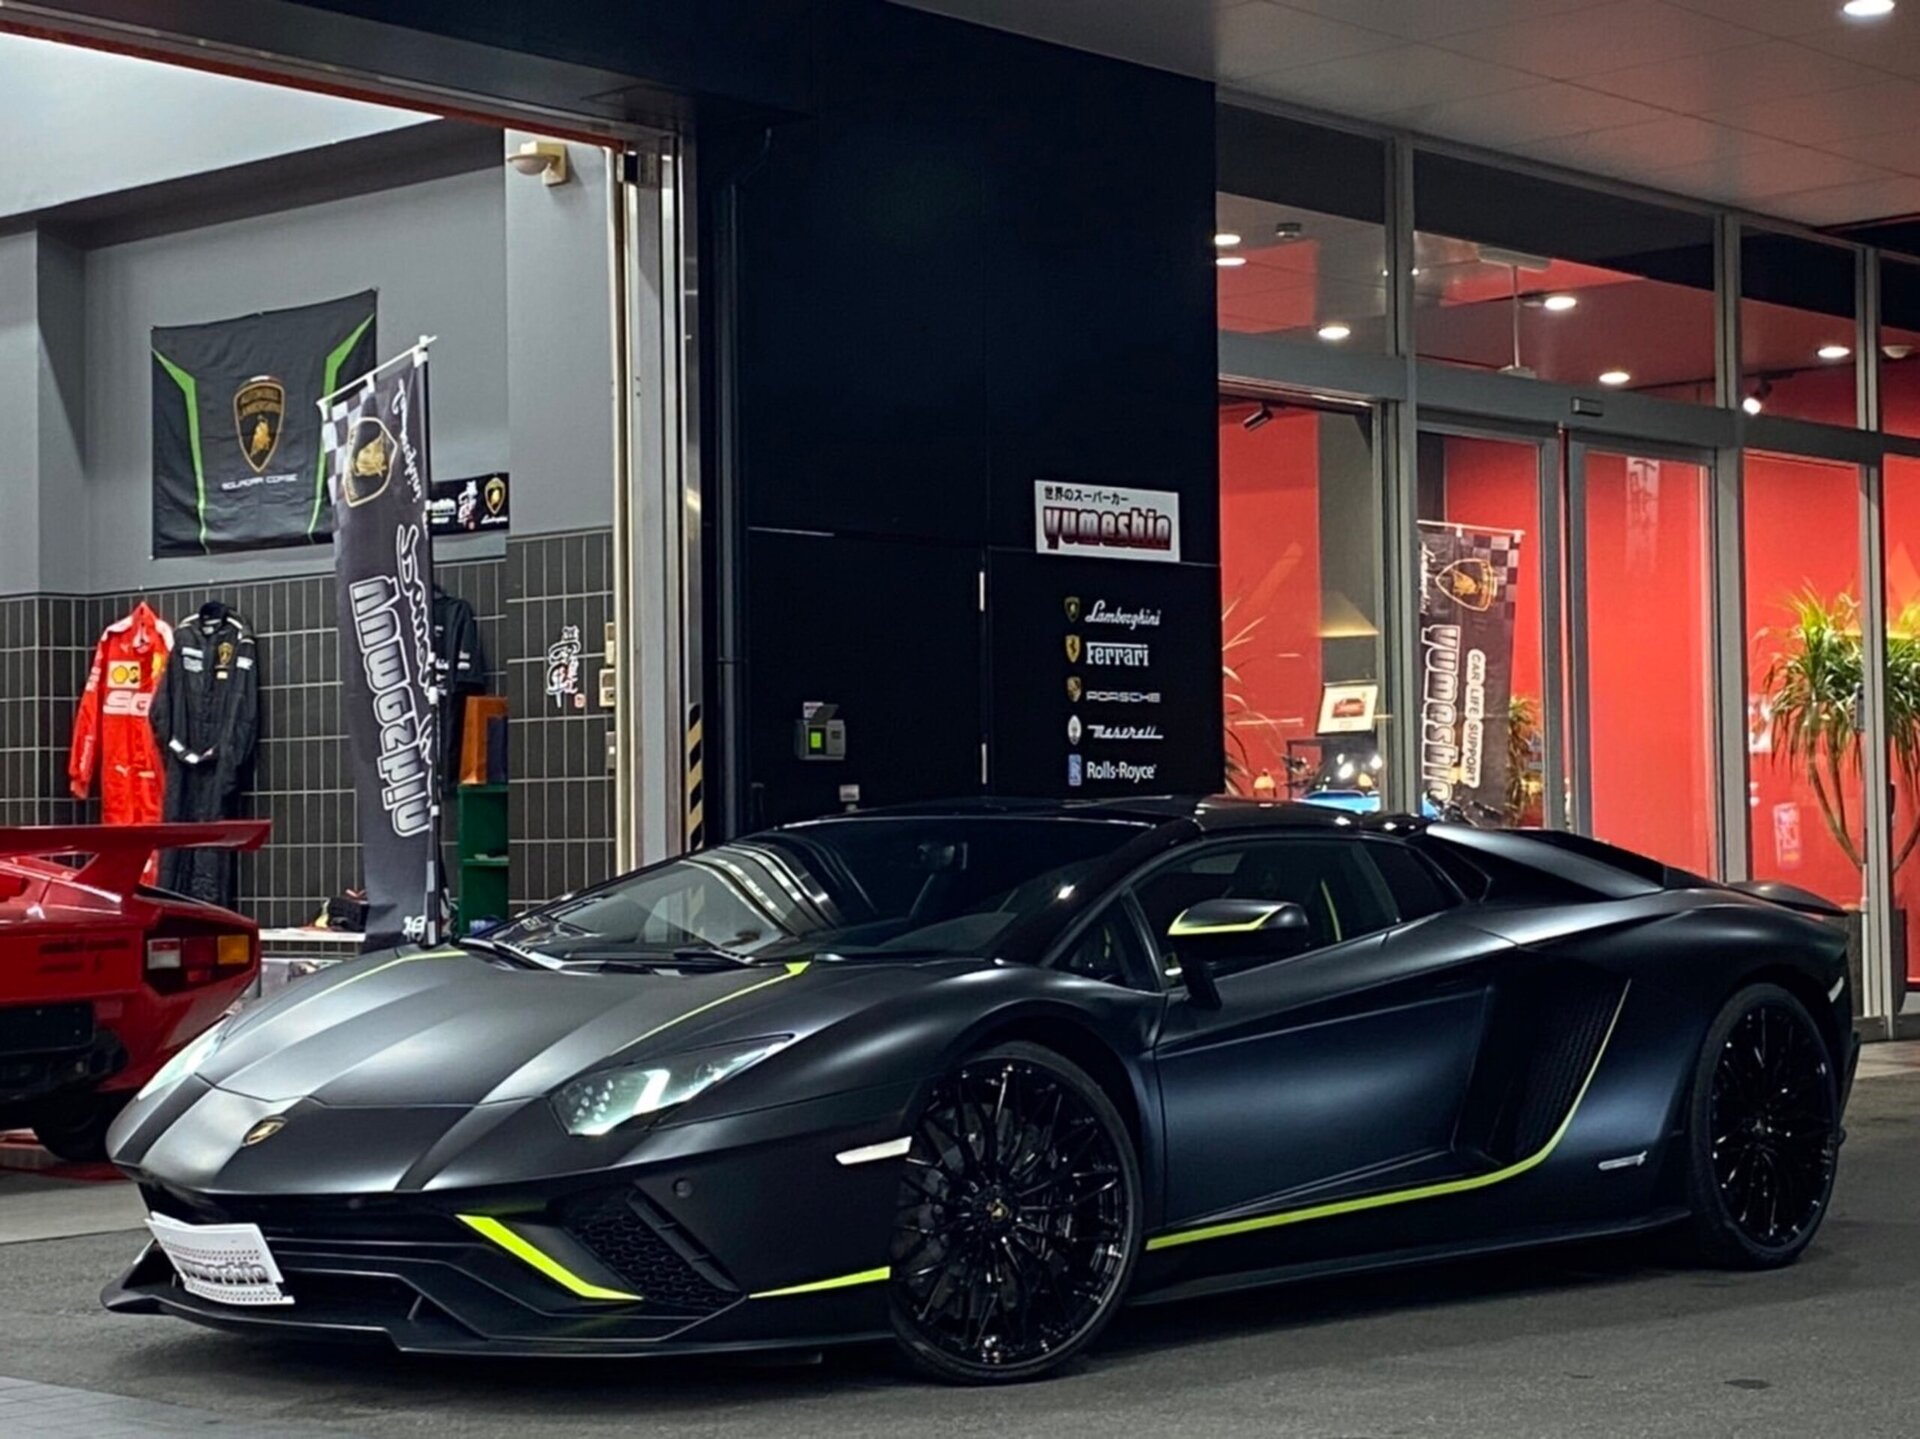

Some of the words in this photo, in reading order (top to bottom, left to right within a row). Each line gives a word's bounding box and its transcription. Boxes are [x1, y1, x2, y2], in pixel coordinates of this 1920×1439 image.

[1044, 485, 1130, 506] 世界のスーパーカー
[1043, 506, 1172, 551] yumeshin
[1085, 599, 1161, 630] Lamborghini
[1086, 642, 1149, 666] Ferrari
[1471, 654, 1483, 683] CAR
[1086, 691, 1161, 703] PORSCHE
[1469, 686, 1481, 715] LIFE
[1465, 723, 1480, 785] SUPPORT
[1086, 760, 1156, 784] Rolls-Royce
